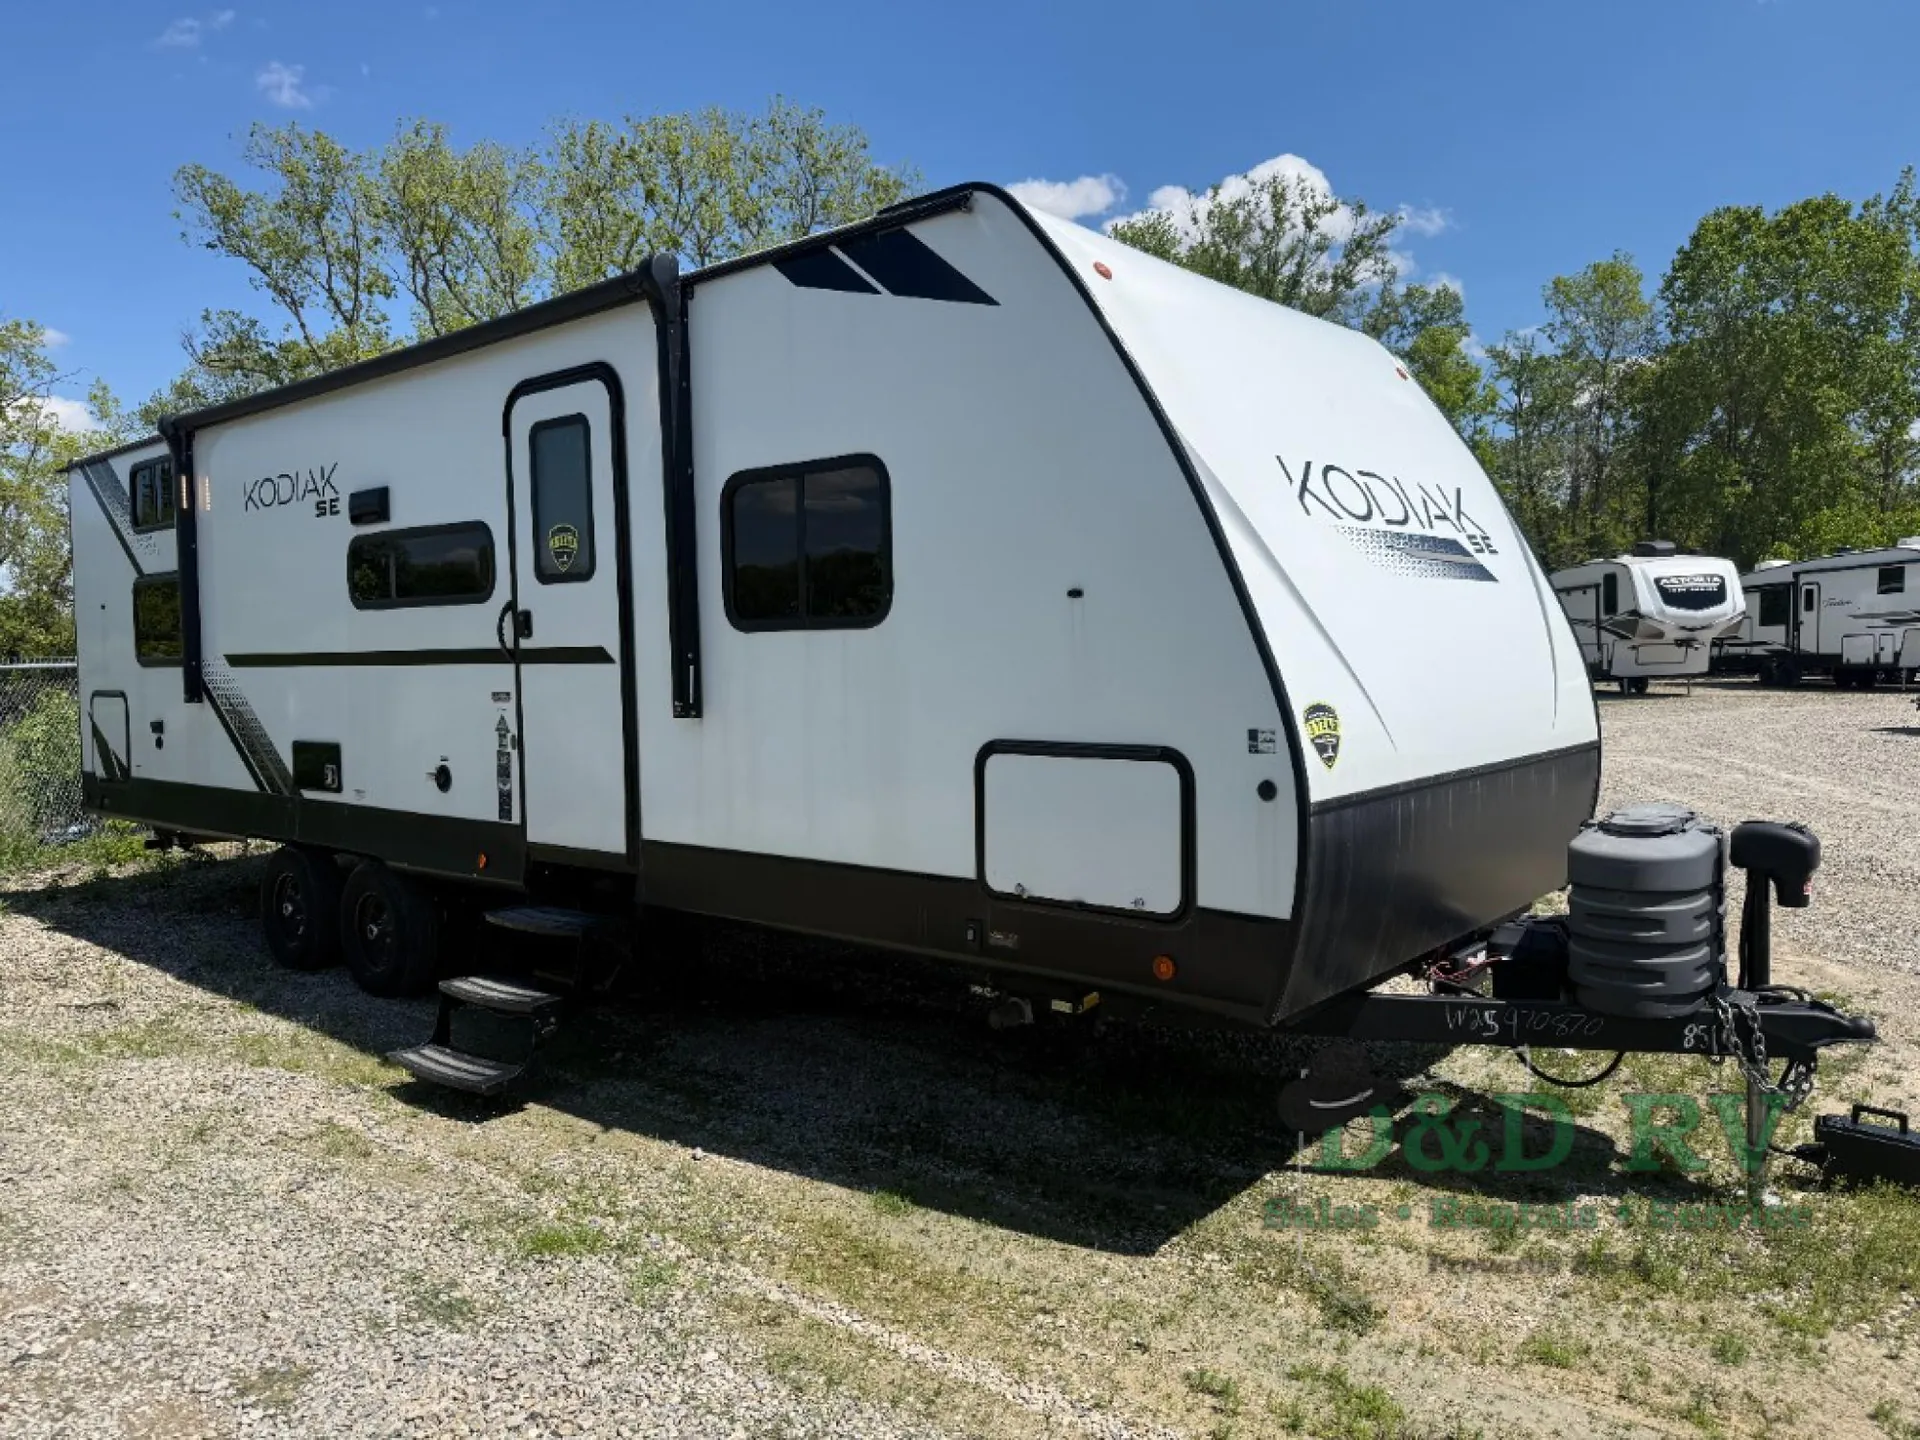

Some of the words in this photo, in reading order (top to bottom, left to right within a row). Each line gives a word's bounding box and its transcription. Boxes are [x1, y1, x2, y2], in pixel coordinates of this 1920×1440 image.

[244, 462, 339, 512] KODIAK
[315, 497, 340, 518] SE
[1275, 454, 1487, 534] KODIAK
